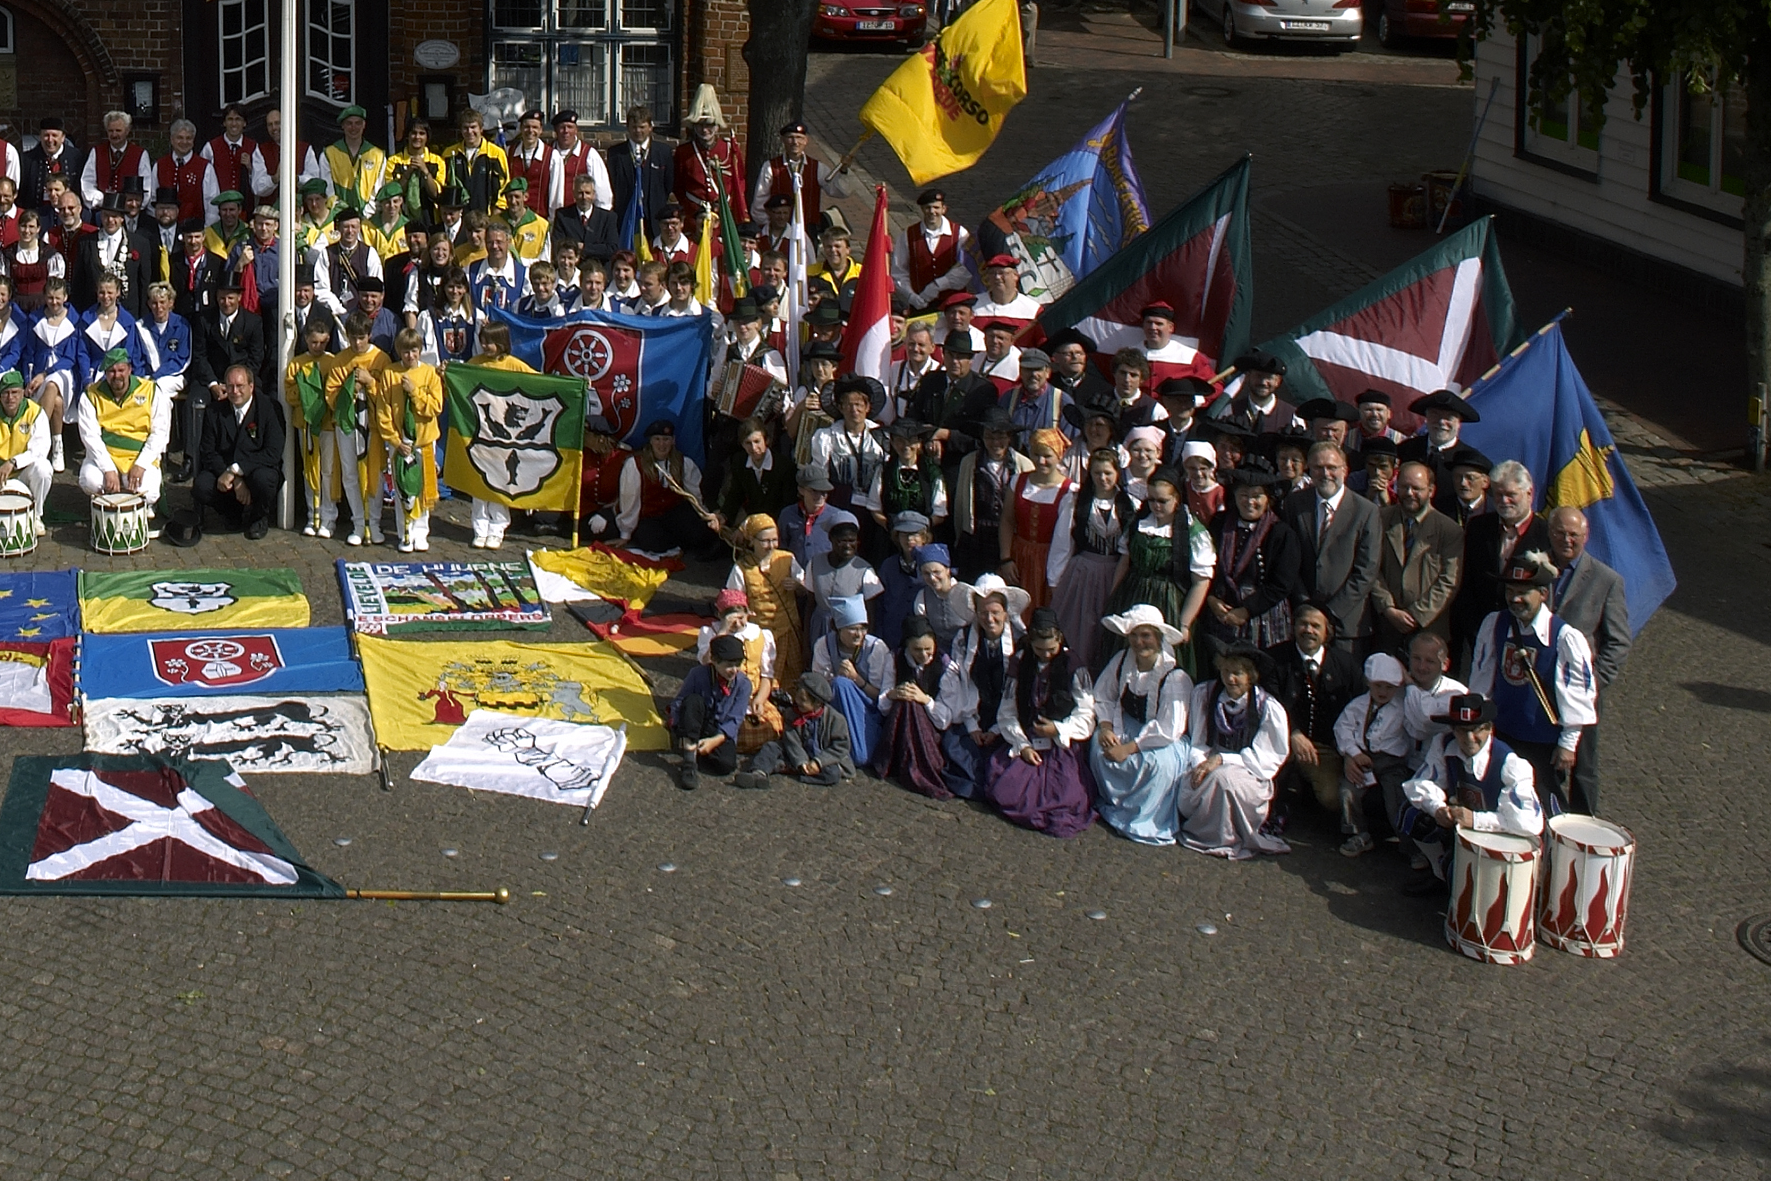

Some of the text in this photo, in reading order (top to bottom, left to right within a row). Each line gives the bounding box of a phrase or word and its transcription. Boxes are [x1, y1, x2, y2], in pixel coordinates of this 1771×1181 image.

[948, 75, 989, 125] CORSO
[346, 564, 382, 615] LIEVELDE
[376, 565, 411, 575] DE
